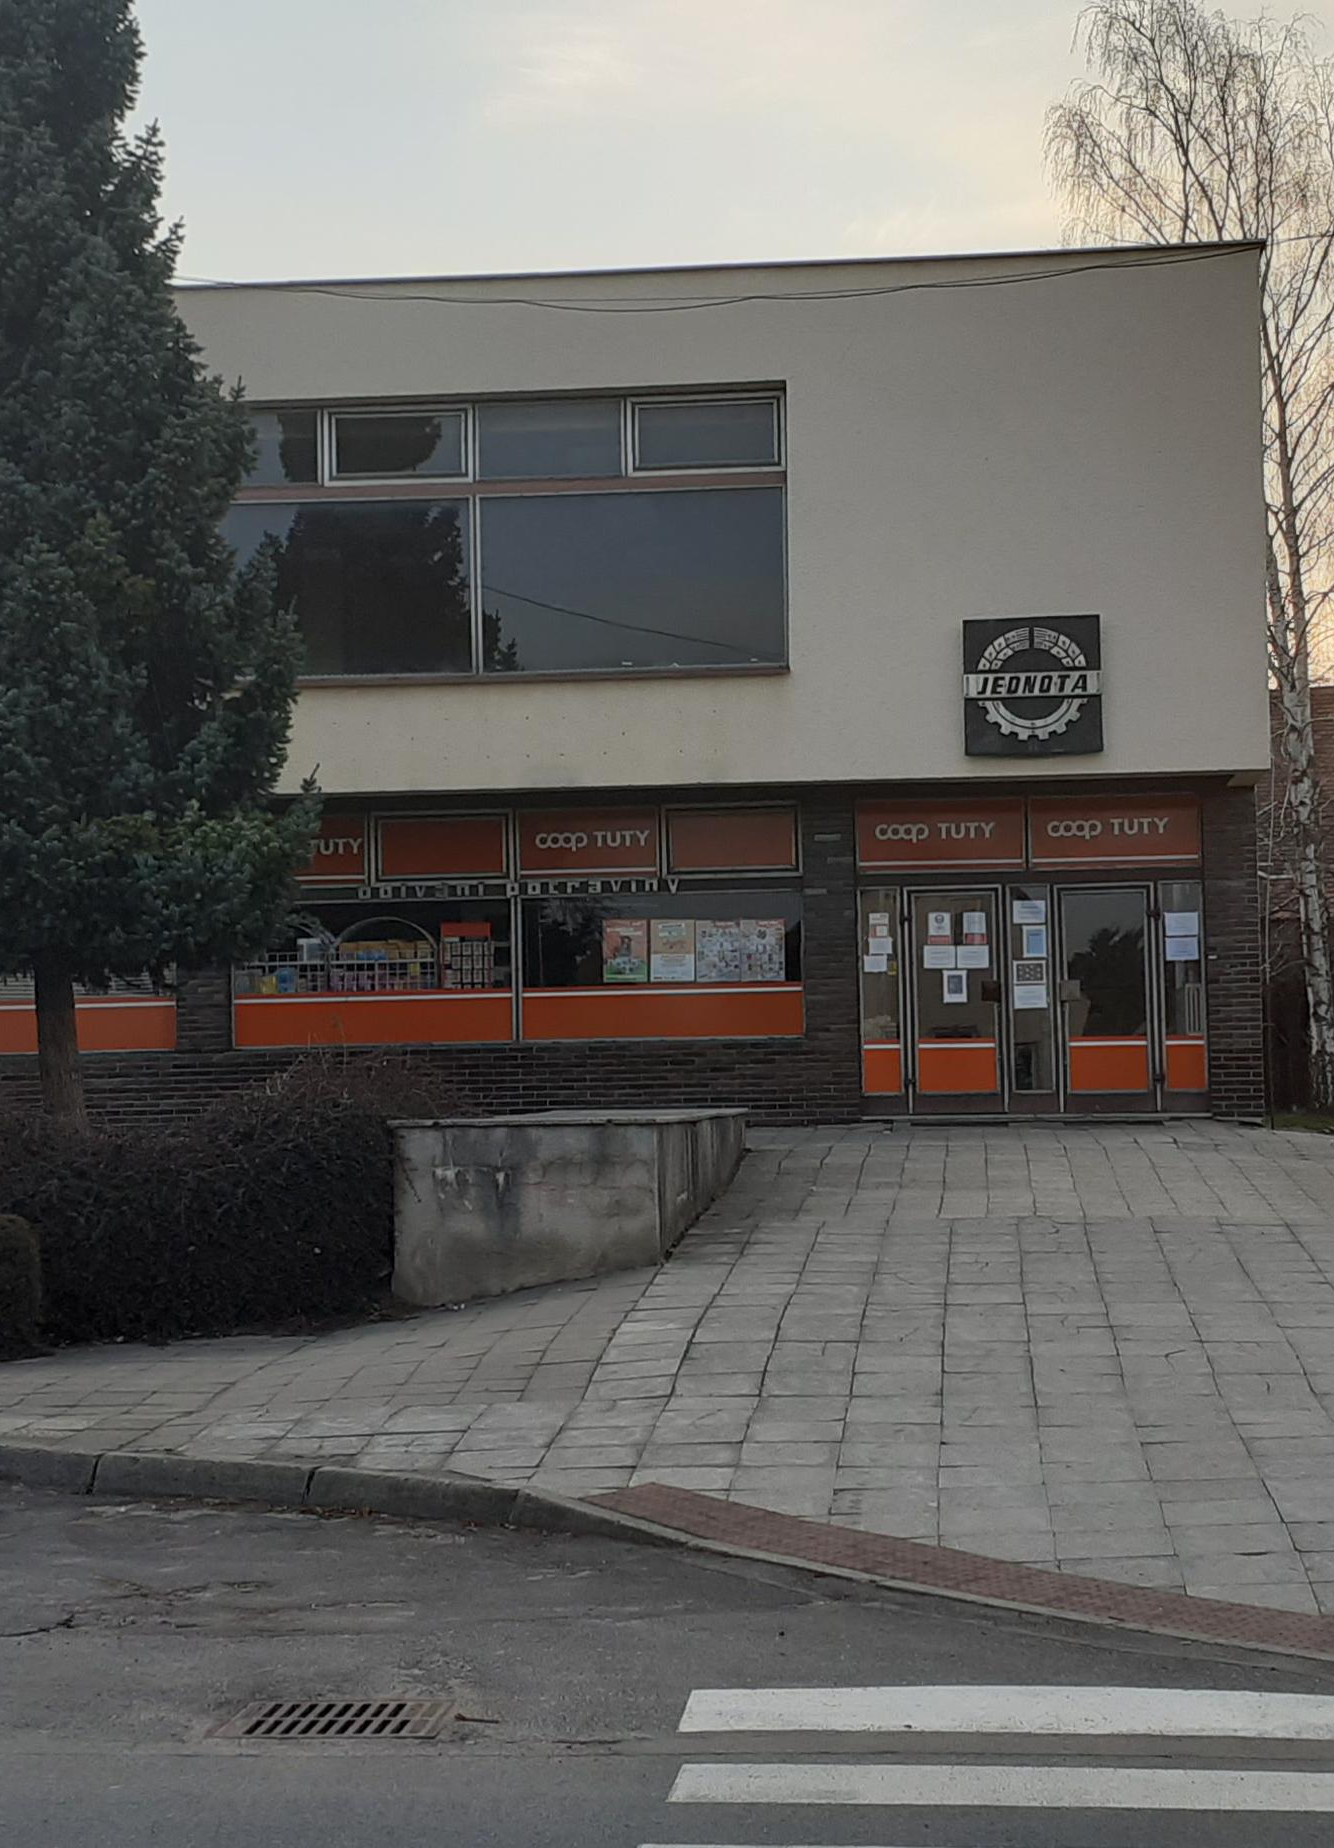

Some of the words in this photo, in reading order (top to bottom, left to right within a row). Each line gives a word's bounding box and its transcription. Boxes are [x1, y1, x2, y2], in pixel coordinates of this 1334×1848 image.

[976, 673, 1088, 696] JEDNOTA
[937, 821, 996, 841] TUTY
[1109, 816, 1169, 836] TUTY
[592, 829, 651, 848] TUTY
